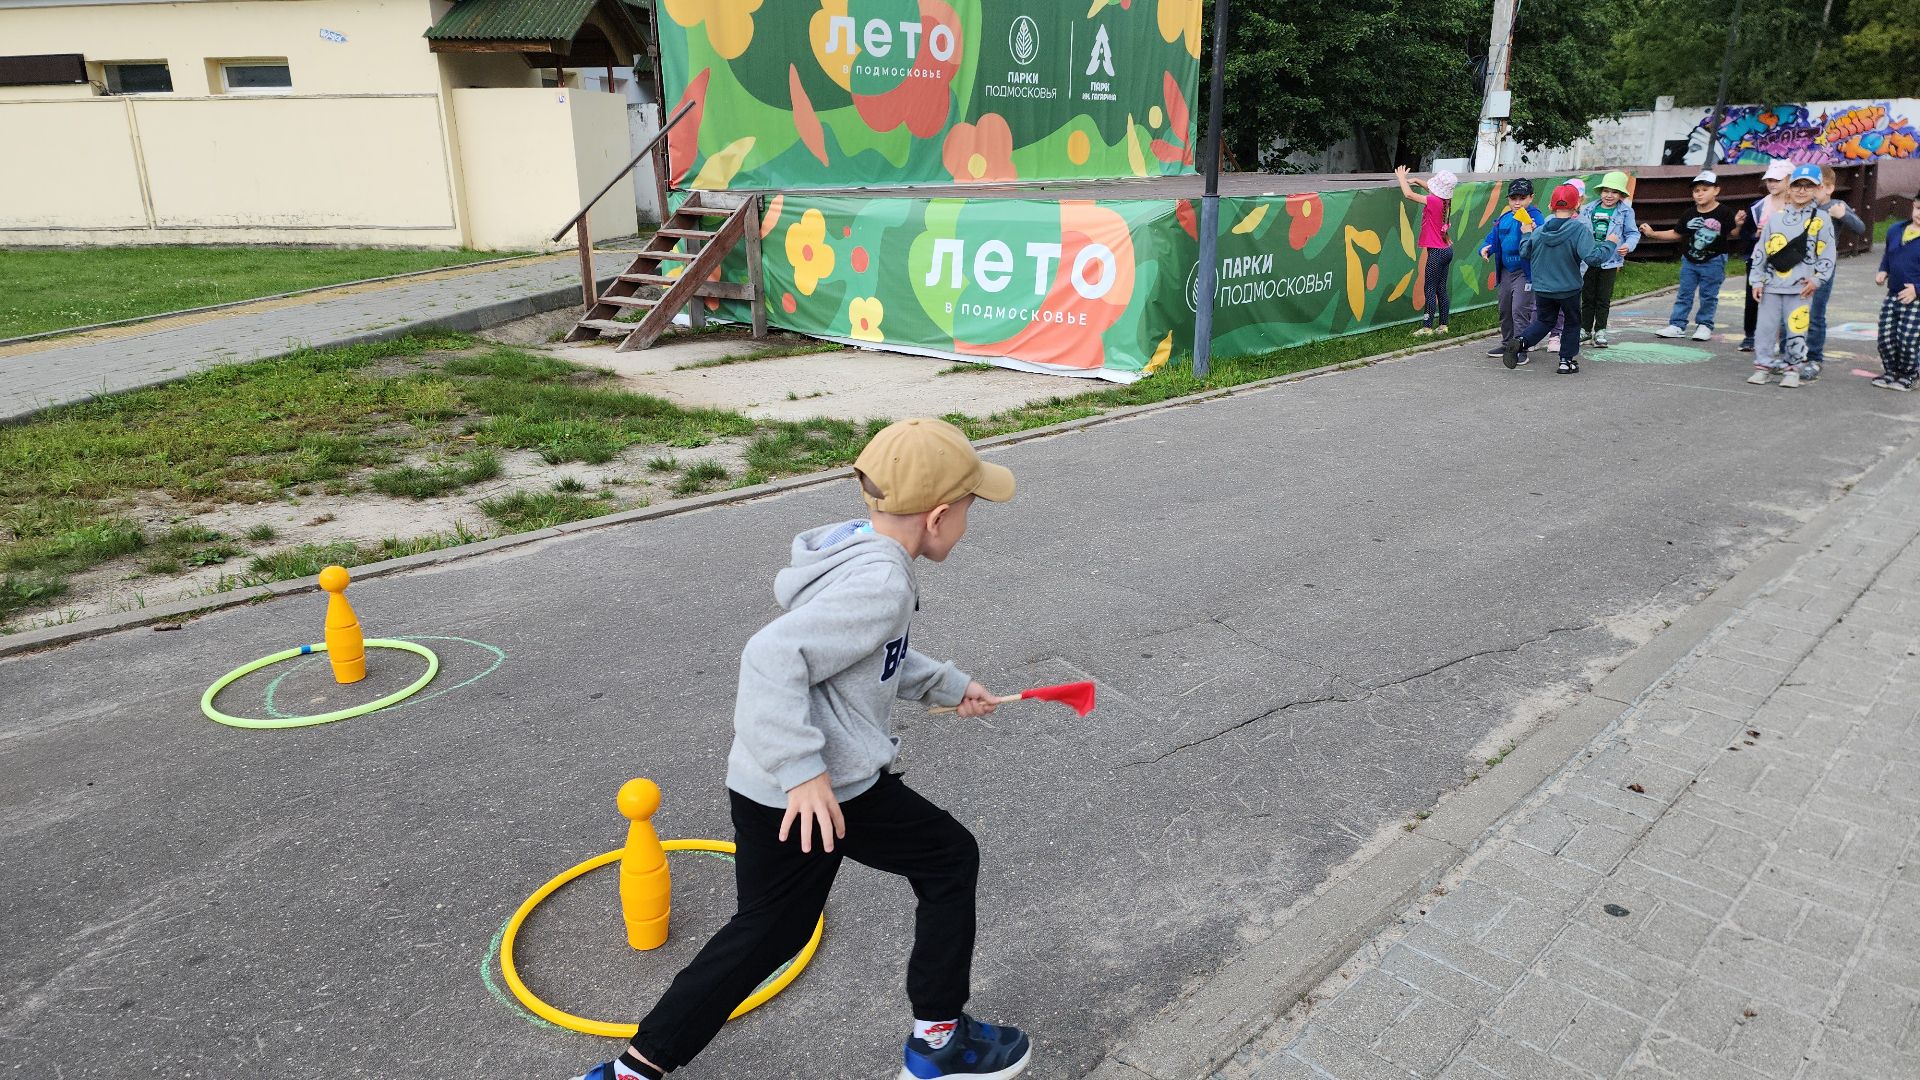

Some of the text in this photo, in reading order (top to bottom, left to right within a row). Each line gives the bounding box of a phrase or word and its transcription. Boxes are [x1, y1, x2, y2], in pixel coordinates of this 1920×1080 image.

[856, 65, 941, 79] ПОДМОСКОВЬЕ
[1007, 71, 1039, 84] ПАРКИ
[985, 85, 1057, 100] ПОДМОСКОВЬЯ
[1090, 81, 1110, 92] ПАРК
[1222, 253, 1274, 280] ПАРКИ
[1219, 271, 1333, 308] ПОДМОСКОВЬЯ
[961, 303, 1088, 326] ПОДМОСКОВЬЕ
